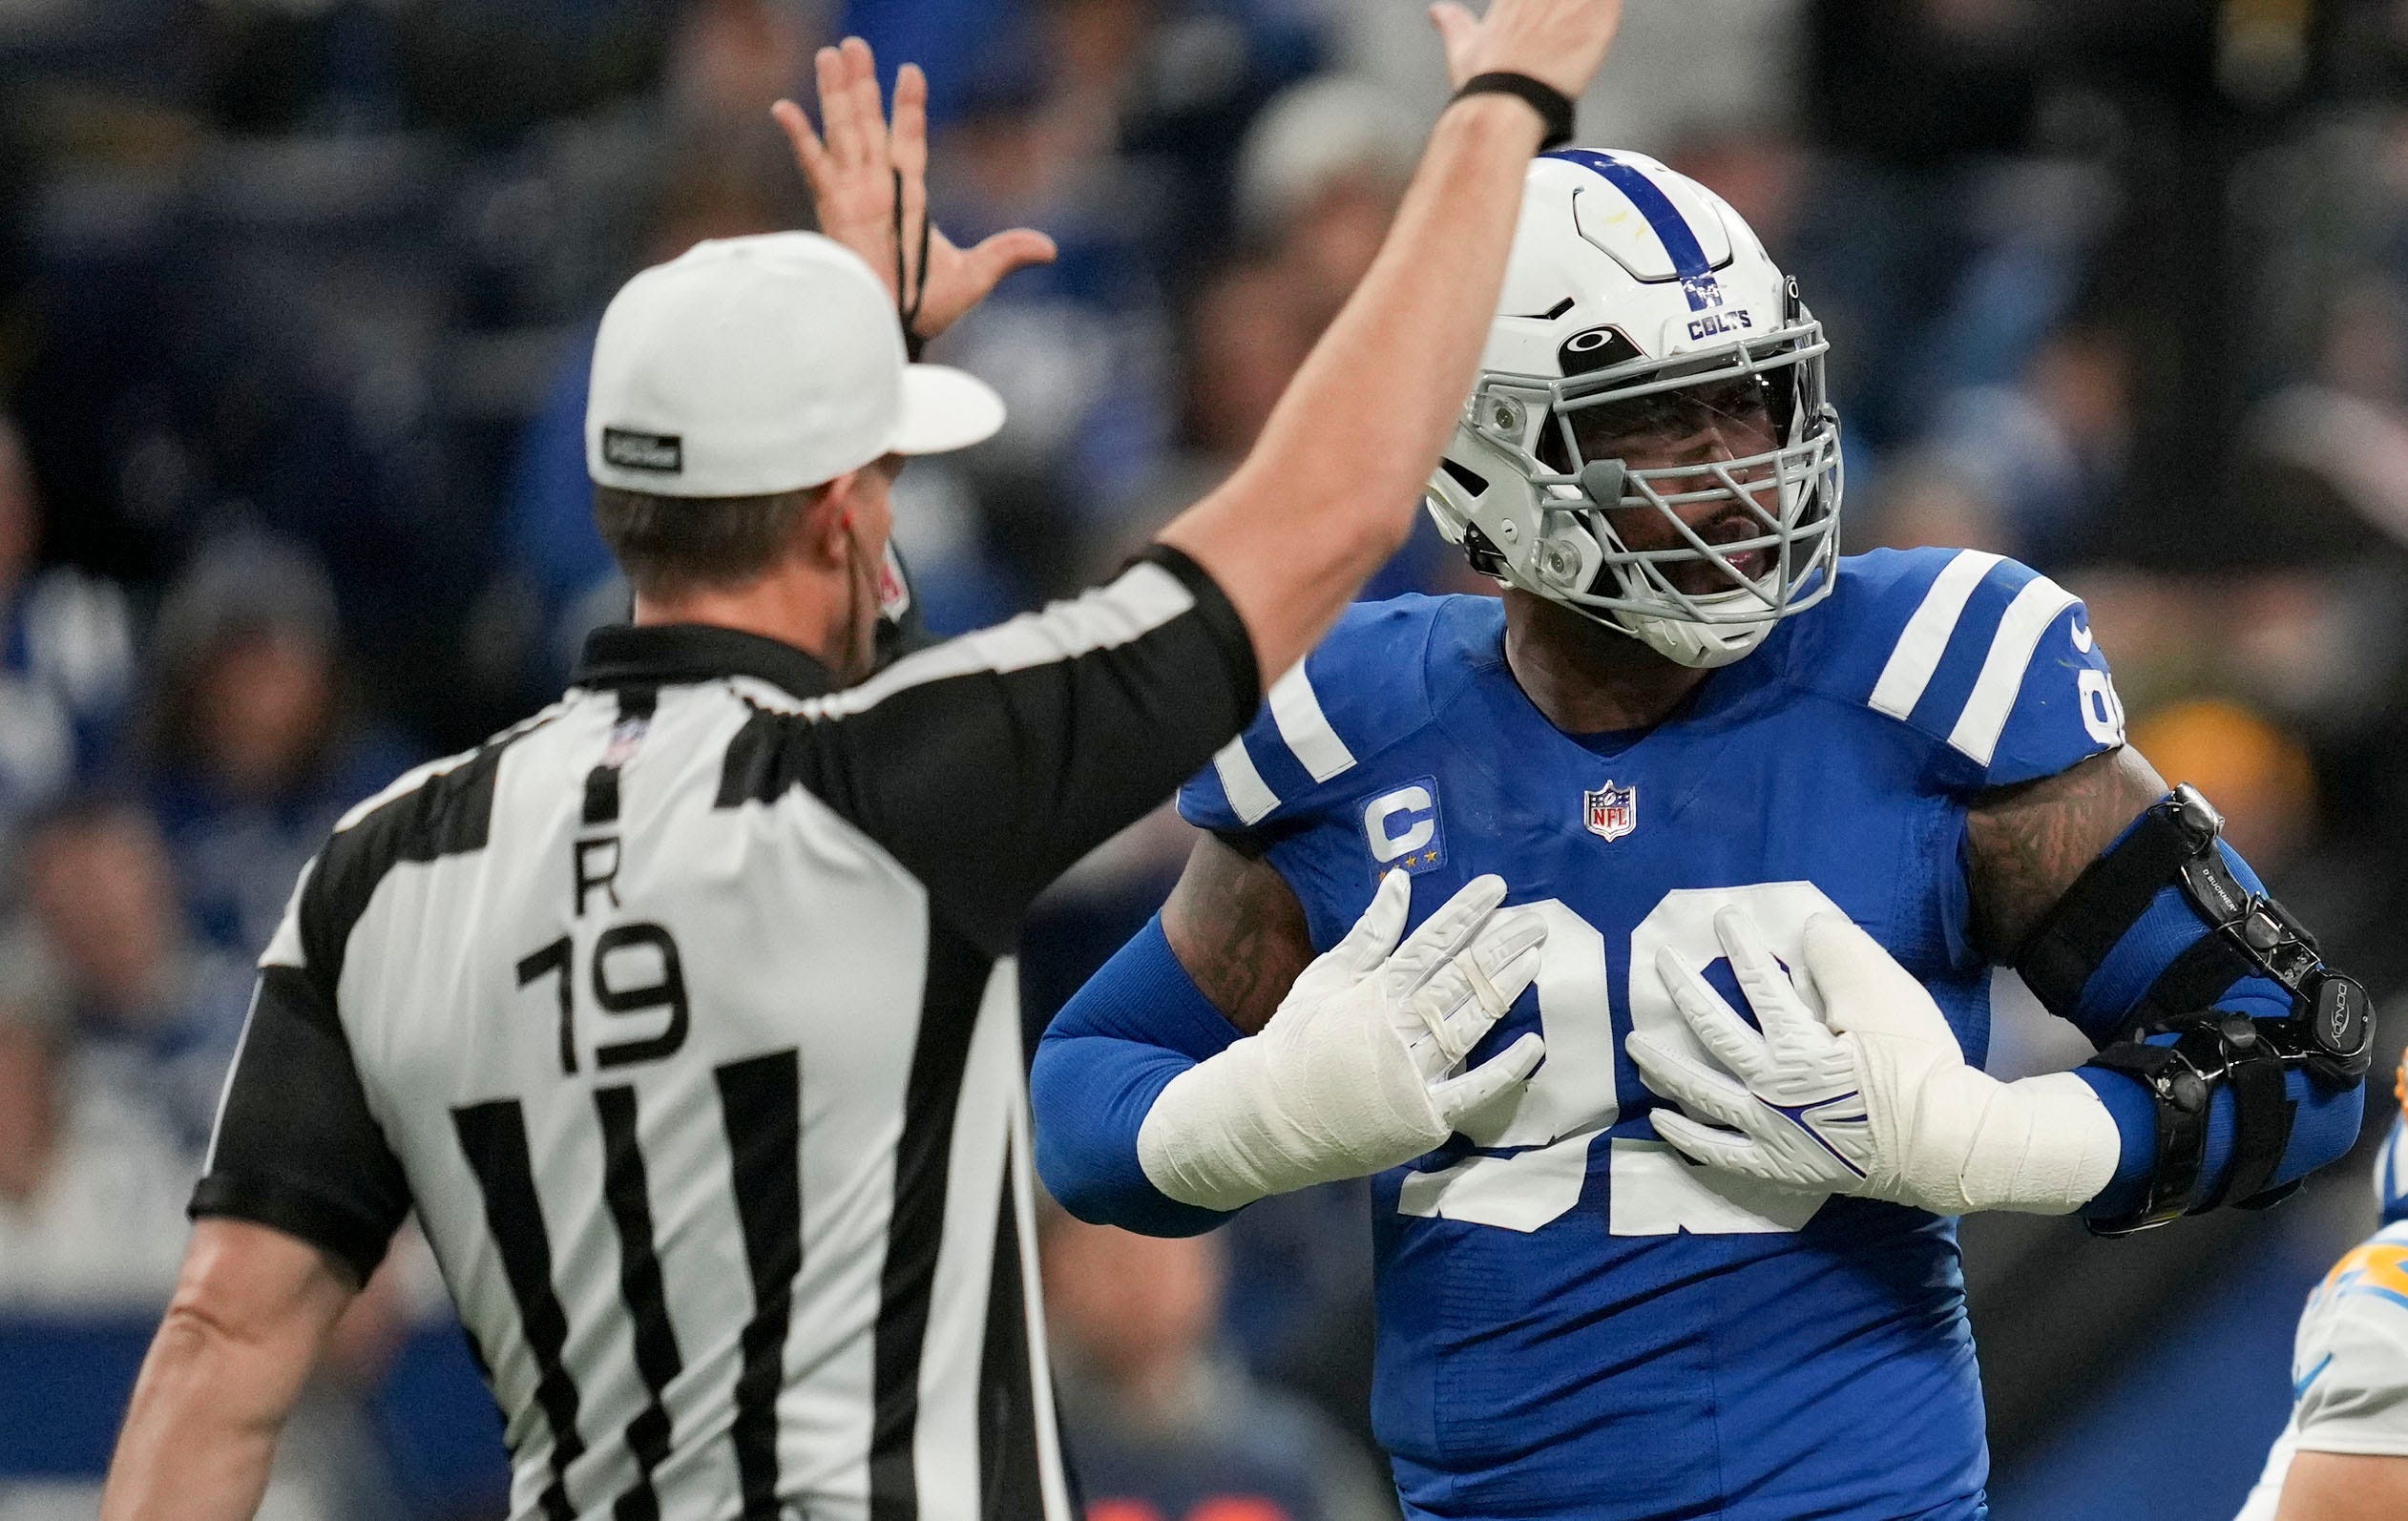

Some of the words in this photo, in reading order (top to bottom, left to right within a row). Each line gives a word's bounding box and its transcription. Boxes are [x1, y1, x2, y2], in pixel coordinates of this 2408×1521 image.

[1687, 310, 1751, 340] COLTS
[1364, 785, 1434, 863] C
[1593, 808, 1627, 828] NFL
[575, 837, 620, 916] R
[515, 923, 690, 1076] 19
[2331, 977, 2348, 1049] DONJOY
